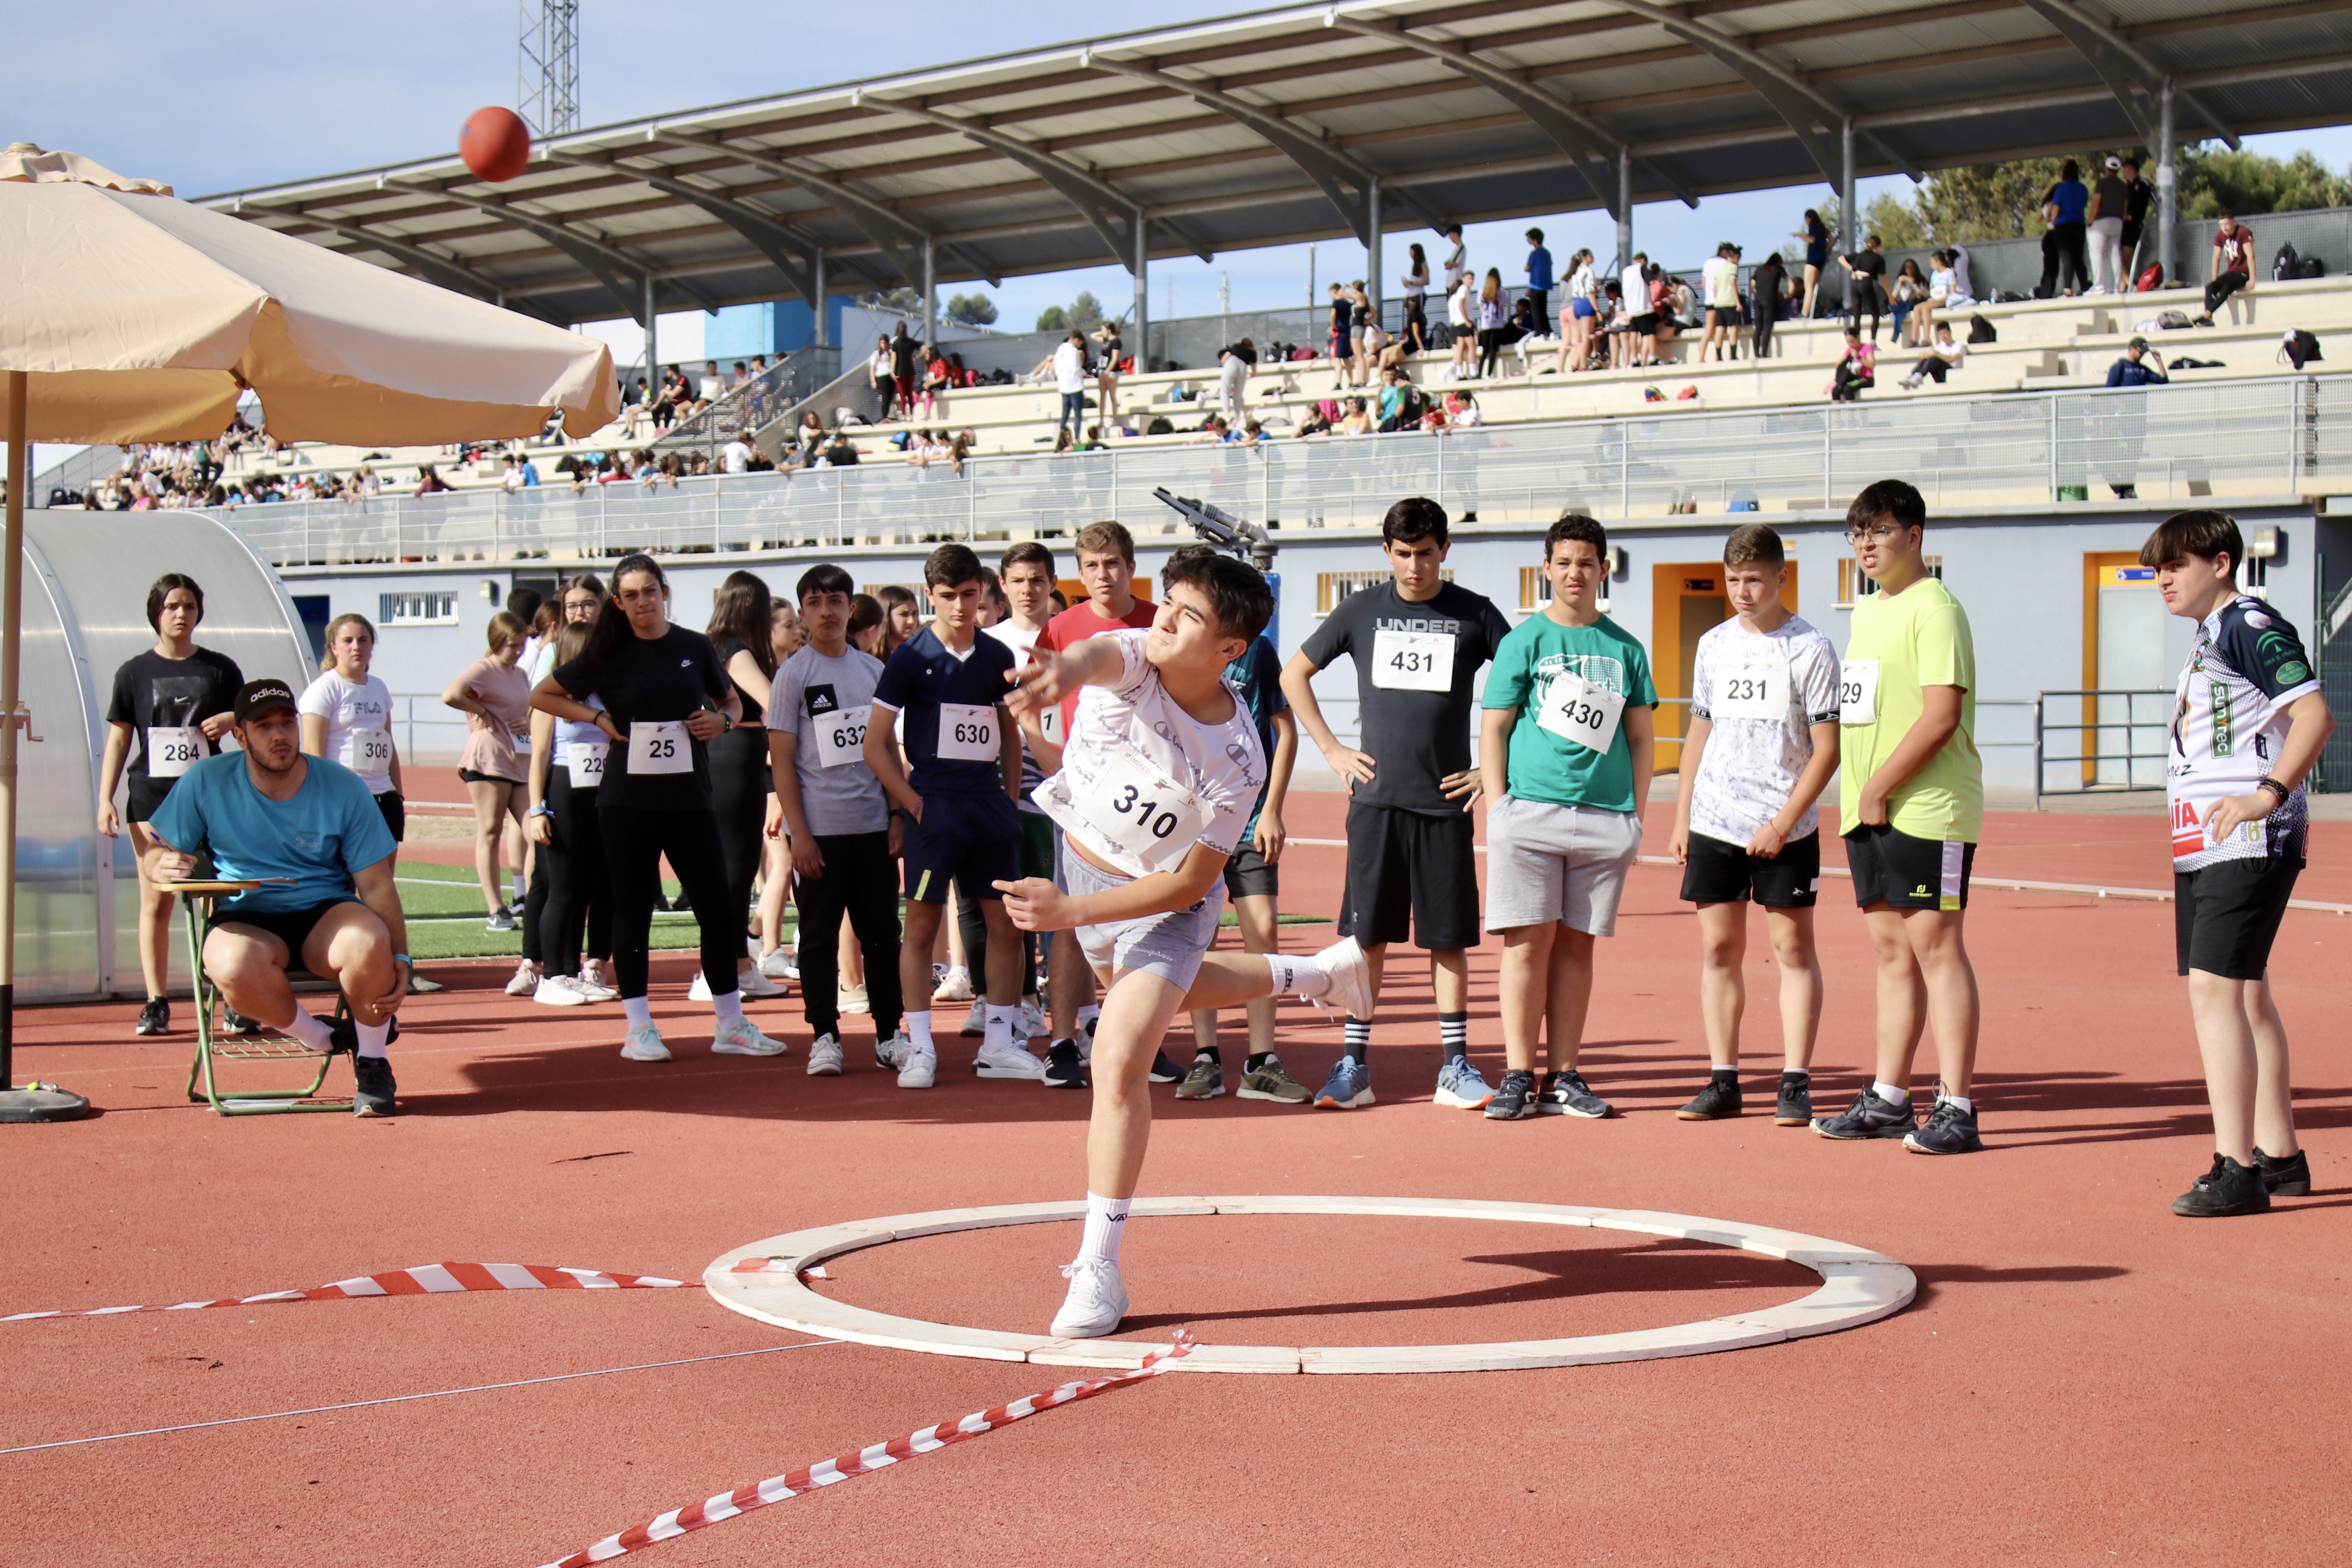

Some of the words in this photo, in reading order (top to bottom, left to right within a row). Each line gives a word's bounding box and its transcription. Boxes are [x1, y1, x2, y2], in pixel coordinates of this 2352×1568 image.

[1412, 387, 1421, 404] 5
[1376, 618, 1461, 633] UNDER
[1390, 651, 1432, 672] 431
[250, 687, 290, 703] adidas
[1727, 679, 1766, 700] 231
[354, 701, 383, 714] FILA
[1560, 699, 1604, 730] 430
[1043, 713, 1053, 731] 1
[833, 724, 867, 748] 632
[955, 723, 990, 744] 630
[164, 743, 200, 761] 284
[365, 742, 388, 759] 306
[649, 740, 675, 757] 25
[1130, 756, 1151, 775] IMDECO
[1113, 784, 1178, 838] 310
[2248, 820, 2260, 842] 6
